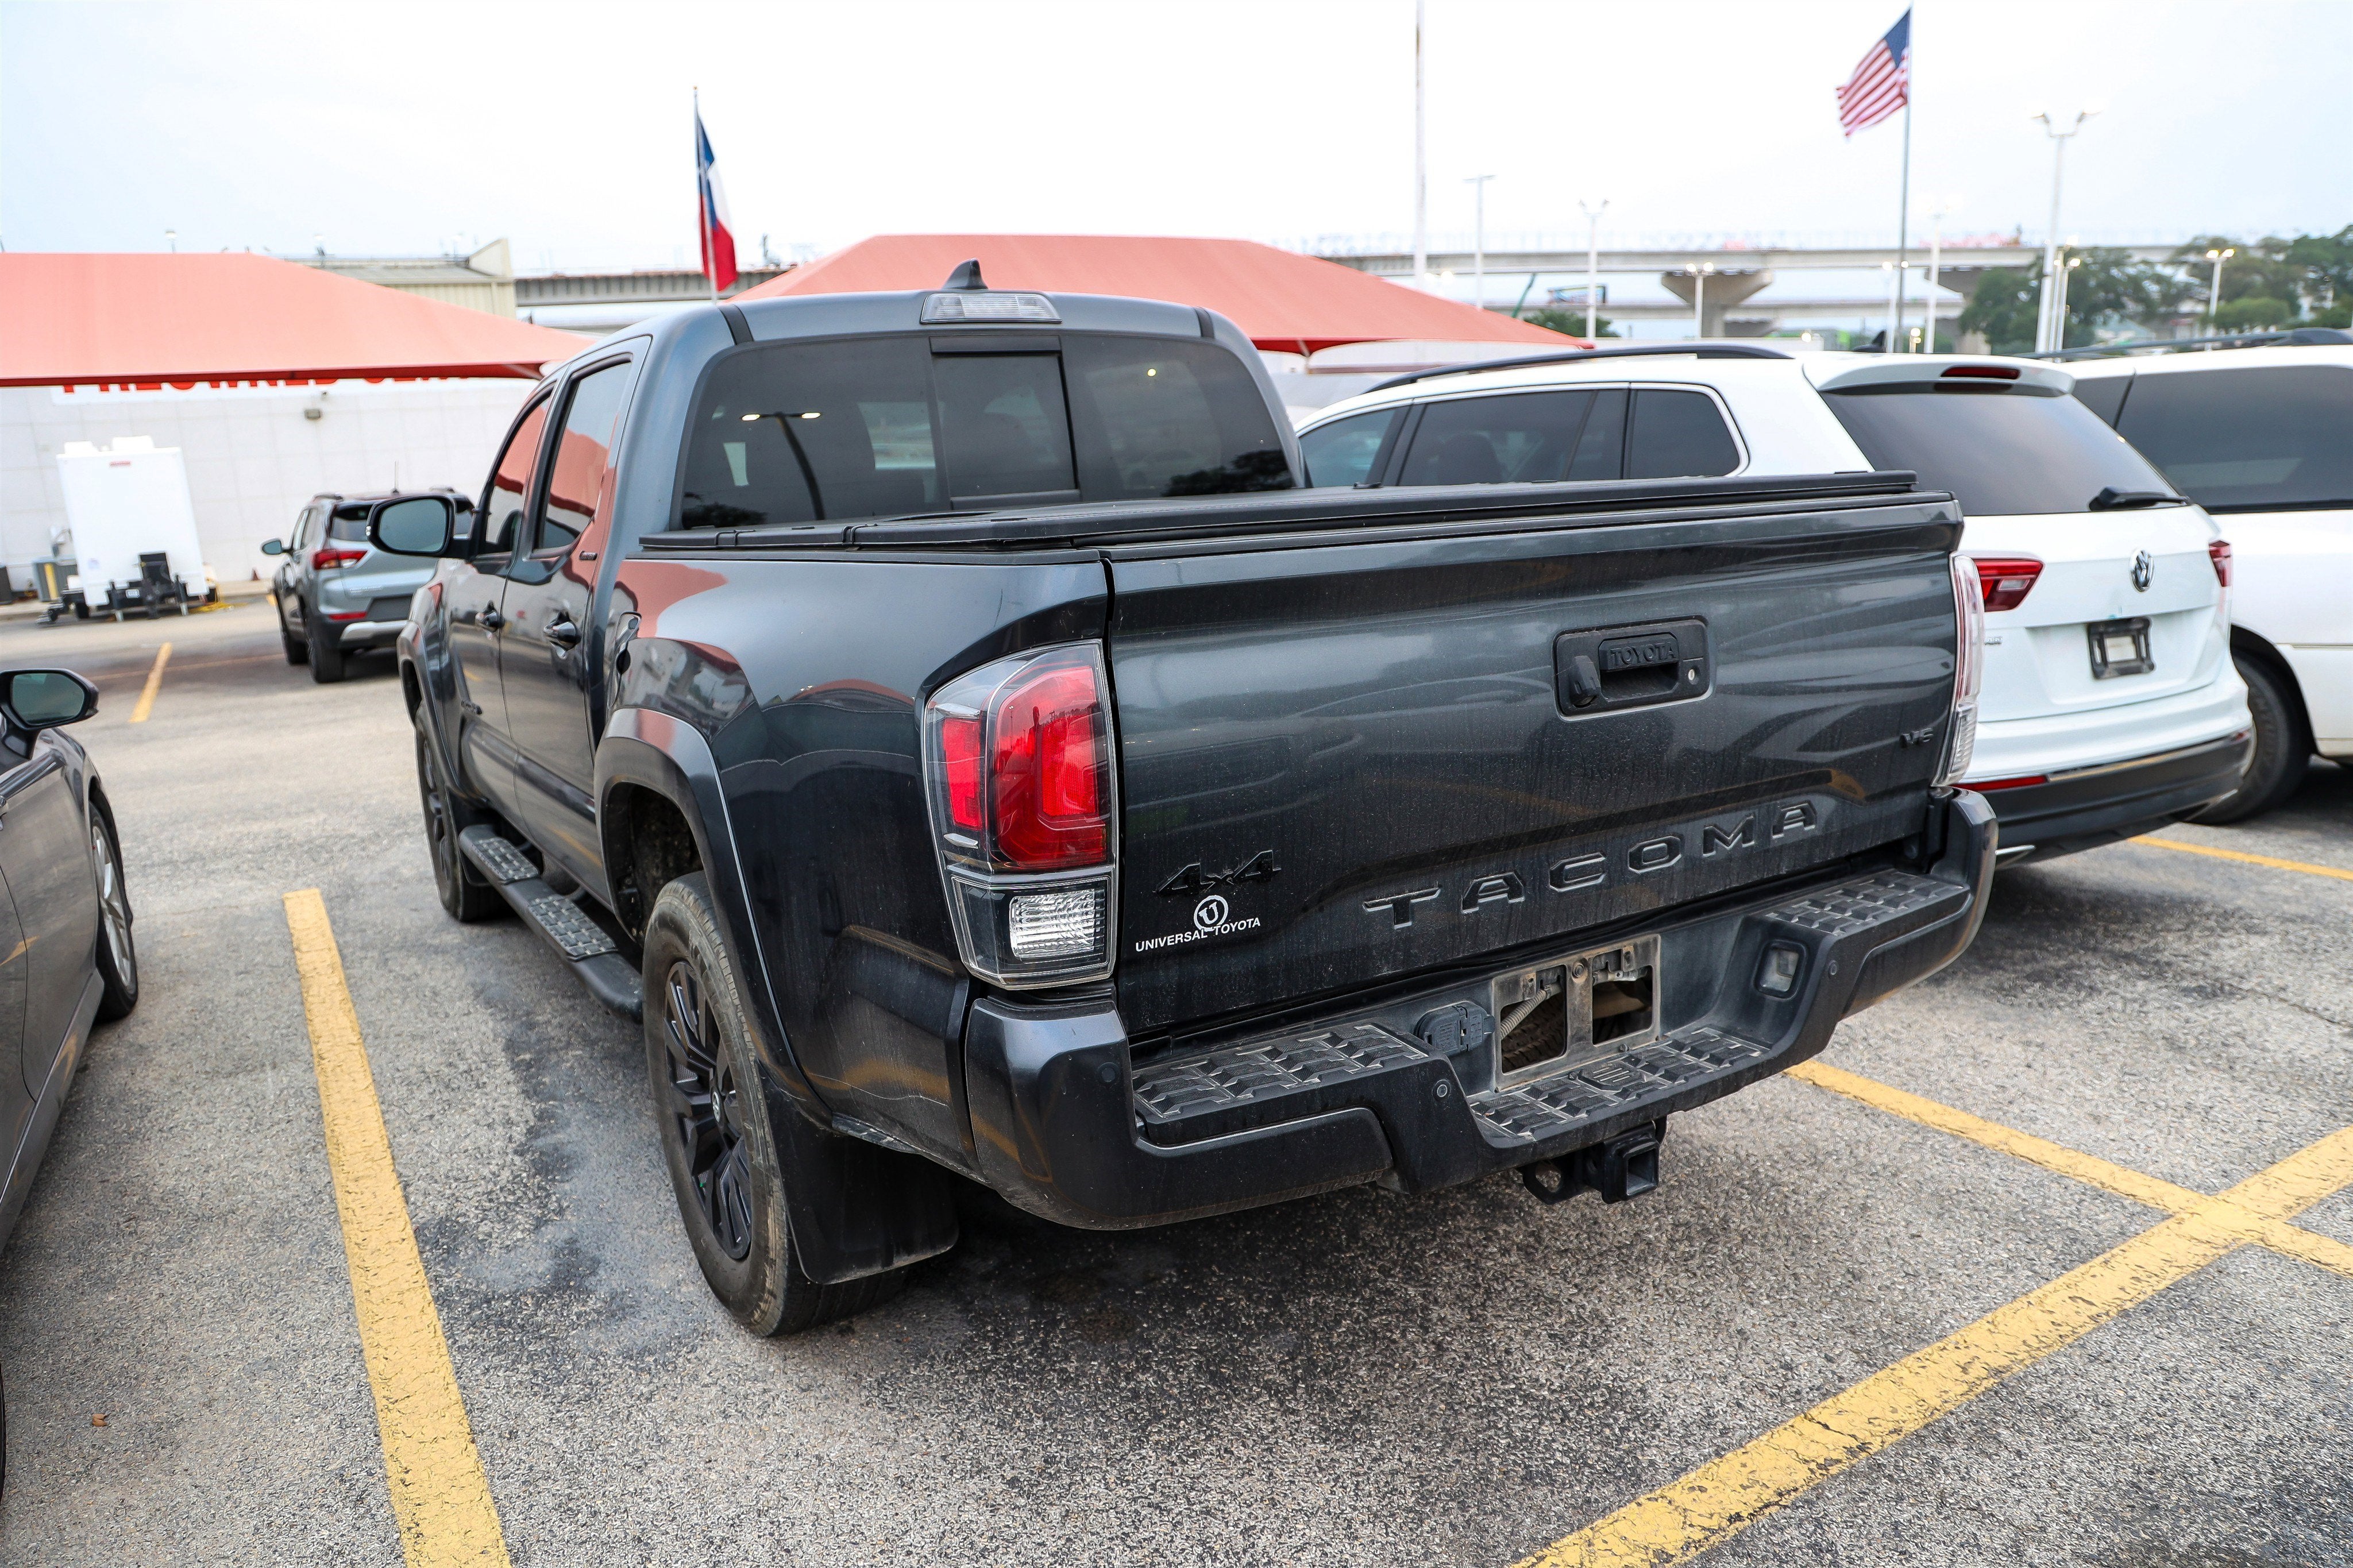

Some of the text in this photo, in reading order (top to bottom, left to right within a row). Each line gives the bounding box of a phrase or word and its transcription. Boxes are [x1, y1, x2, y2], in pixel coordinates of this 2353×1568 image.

[1610, 642, 1676, 666] TOYOTA
[1900, 727, 1934, 748] V6
[1362, 800, 1818, 930] TACOMA
[1135, 917, 1261, 952] UNIVERSAL TOYOTA
